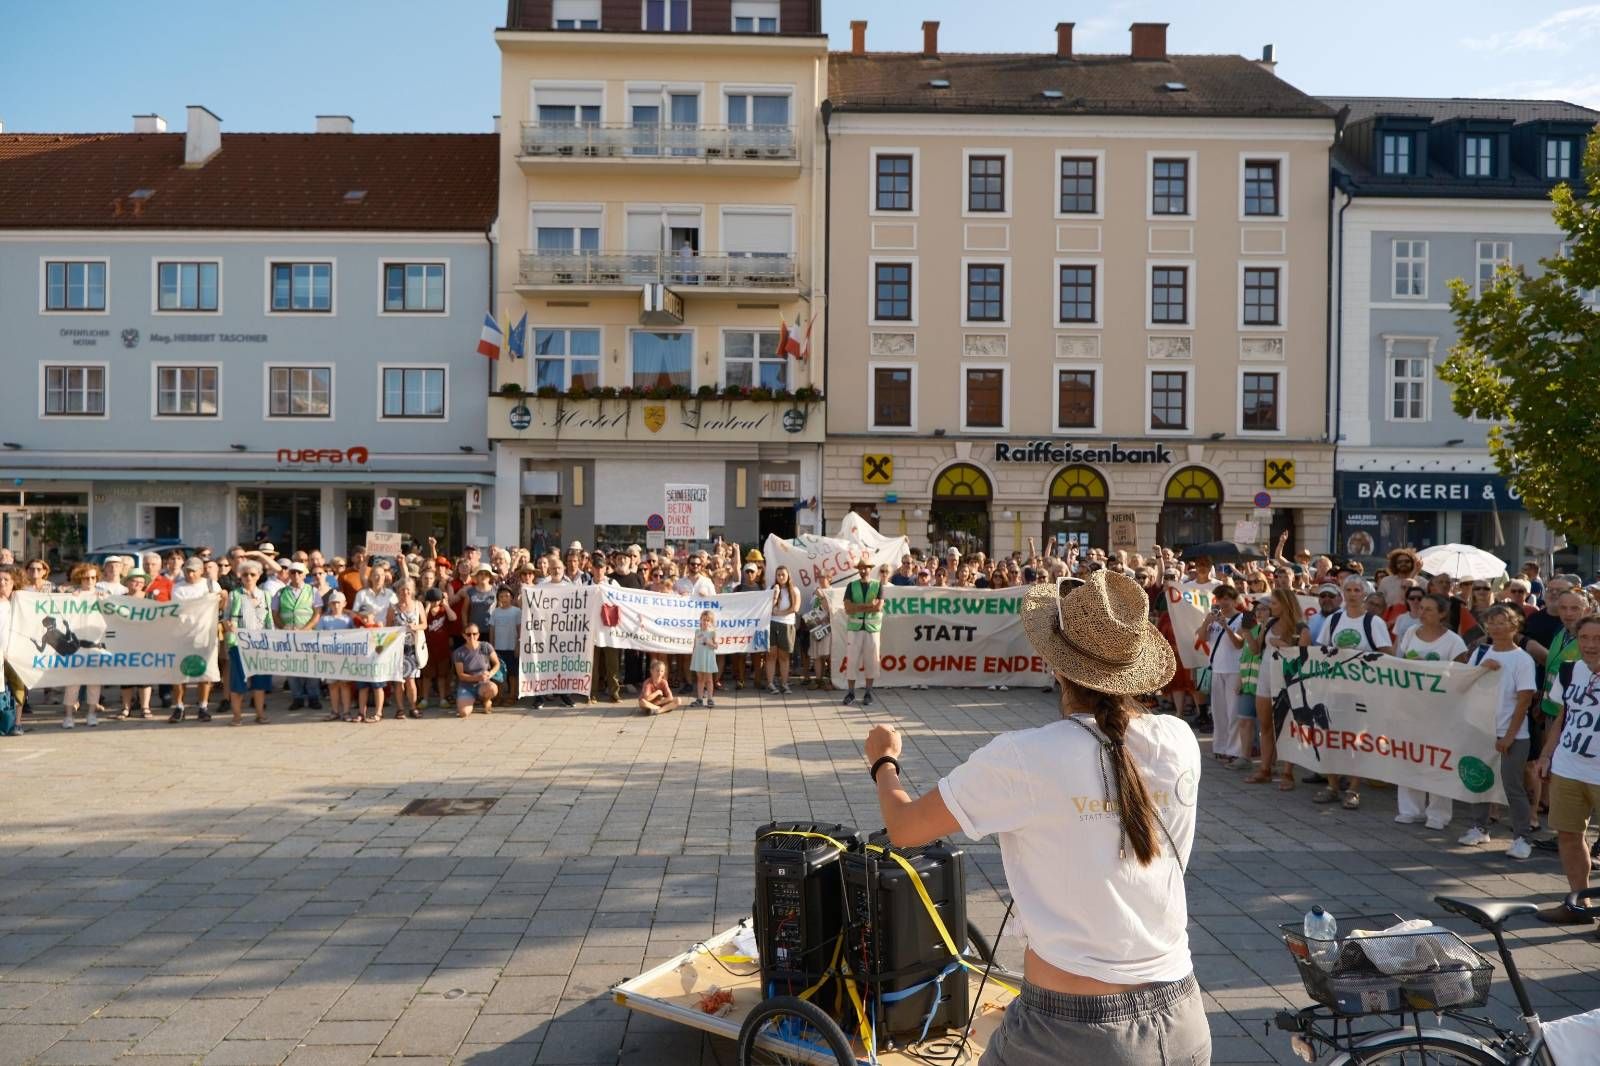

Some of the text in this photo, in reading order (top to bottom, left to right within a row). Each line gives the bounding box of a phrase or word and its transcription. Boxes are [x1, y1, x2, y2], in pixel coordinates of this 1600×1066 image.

[150, 333, 268, 344] Mag. HERBERT TASCHNER
[995, 442, 1171, 464] Raiffeisenbank
[763, 480, 793, 492] HOTEL
[1358, 481, 1469, 499] BÄCKEREI
[1482, 485, 1495, 500] &
[668, 503, 692, 514] BETON
[667, 526, 695, 537] FLUTEN
[525, 589, 588, 613] Wer gibt
[35, 600, 179, 621] KLIMASCHUTZ
[526, 613, 590, 632] der Politik
[654, 617, 699, 628] GROSSE
[609, 631, 752, 645] KLIMAGERECHTIG JETZT
[914, 624, 977, 642] STATT
[272, 633, 291, 652] und
[293, 632, 320, 653] Land
[524, 634, 587, 654] das Recht
[33, 652, 176, 669] KINDERRECHT
[522, 661, 559, 673] unsere
[913, 655, 977, 671] OHNE
[1563, 732, 1597, 758] OIL
